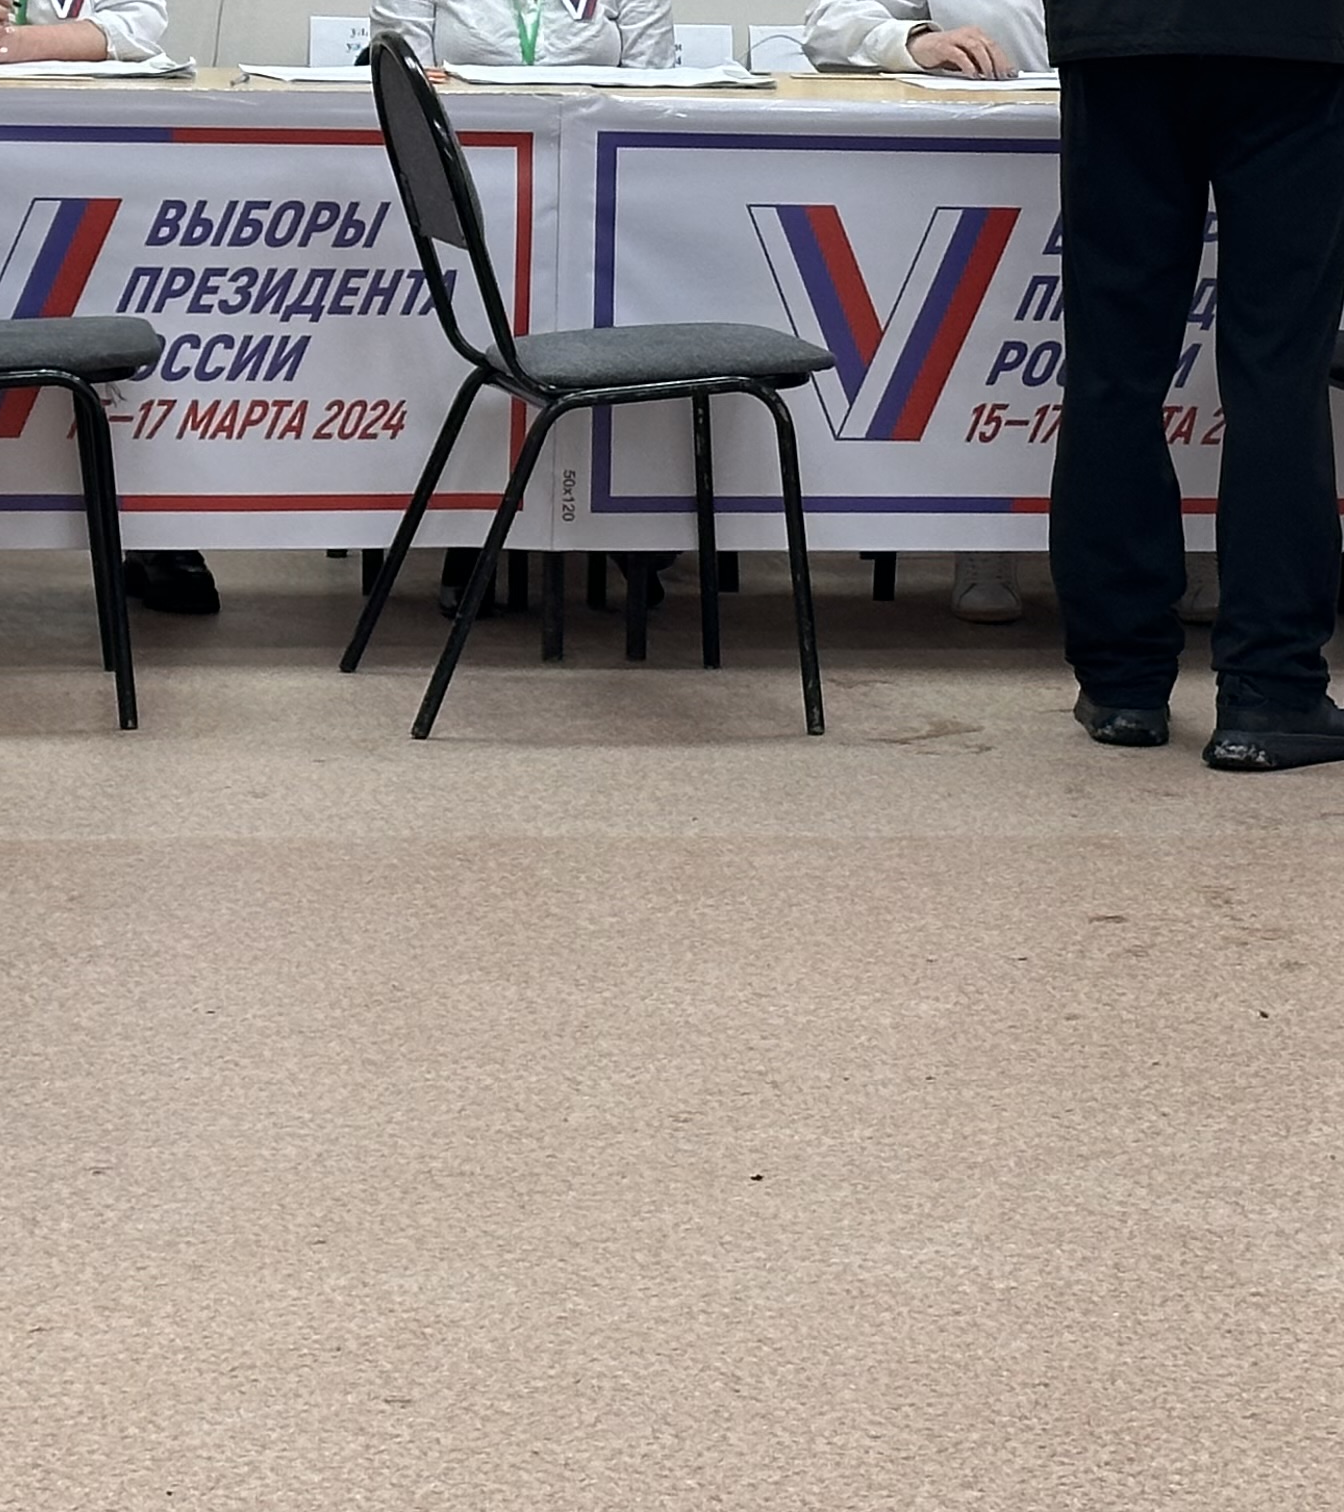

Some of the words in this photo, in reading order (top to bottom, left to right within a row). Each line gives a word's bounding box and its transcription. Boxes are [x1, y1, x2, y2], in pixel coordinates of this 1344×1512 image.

[144, 199, 392, 249] ВЫБОРЫ
[128, 334, 312, 382] ССИИ
[177, 399, 309, 440] МАРТА
[312, 399, 407, 441] 2024
